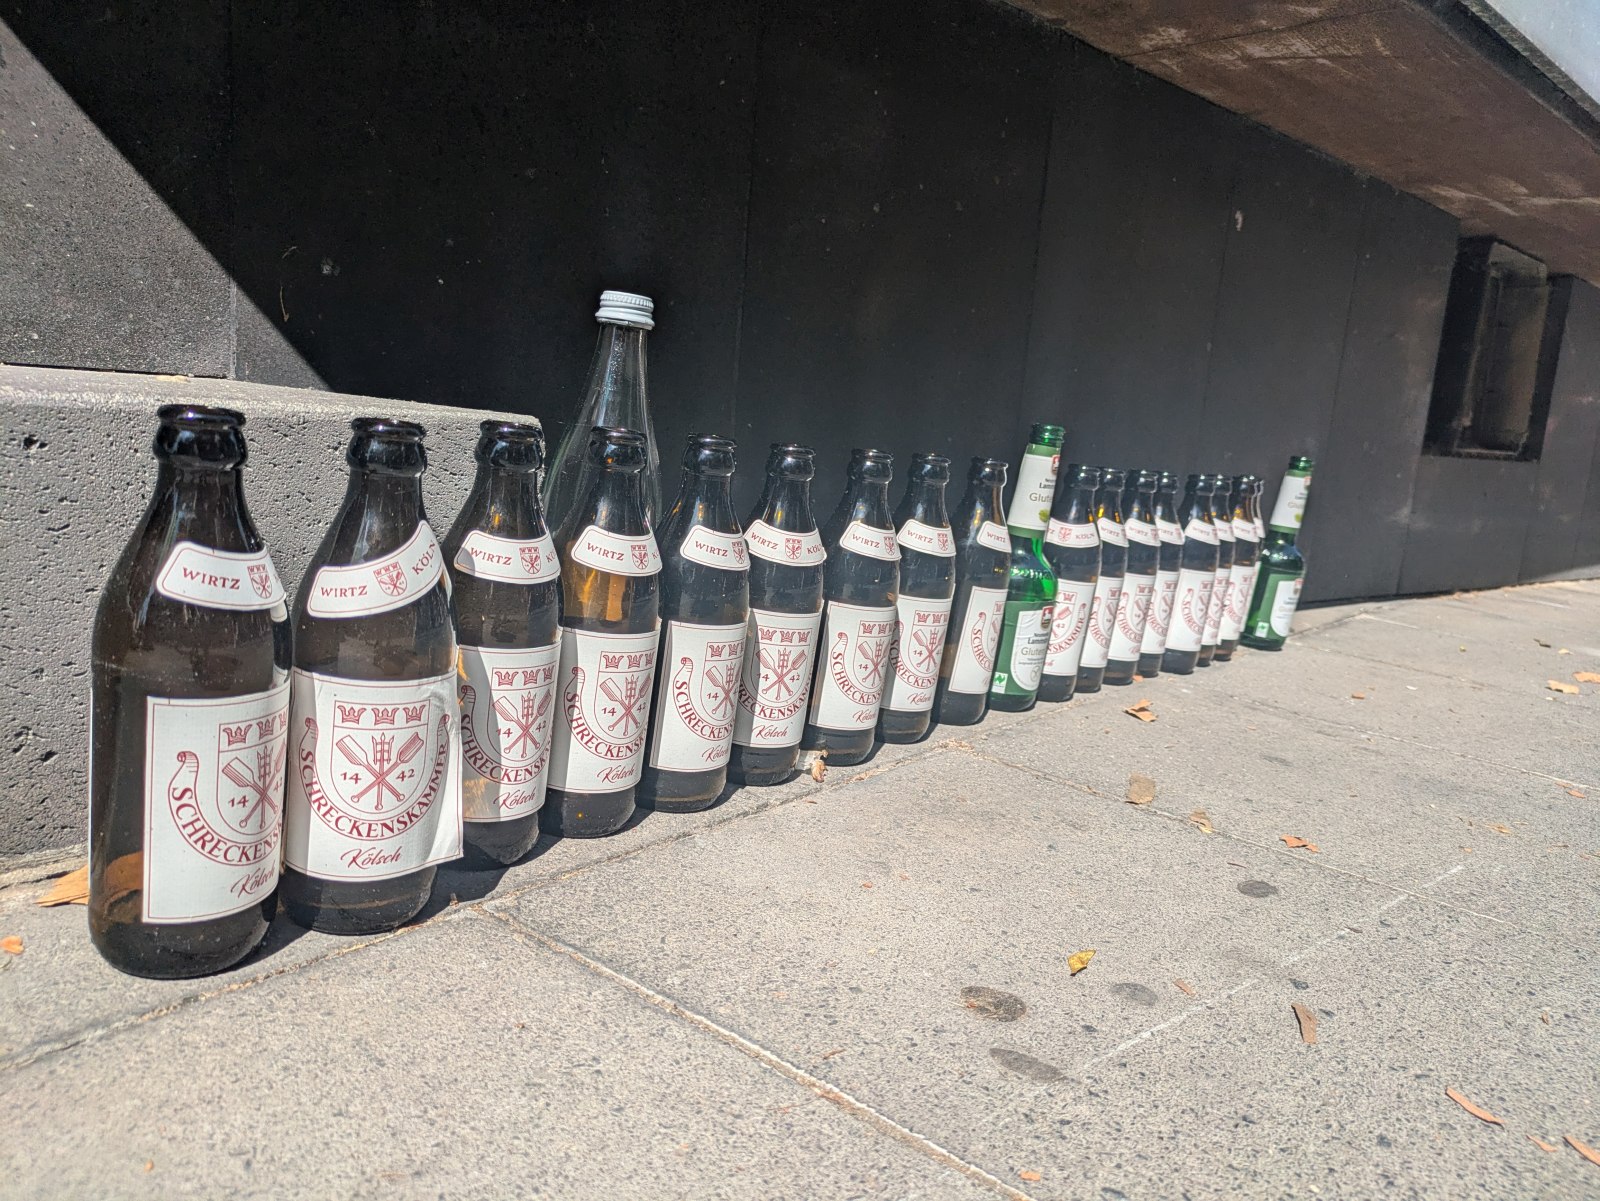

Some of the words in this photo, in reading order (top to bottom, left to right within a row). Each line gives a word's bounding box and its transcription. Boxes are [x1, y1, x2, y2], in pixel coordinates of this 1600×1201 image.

[751, 532, 780, 550] WIRTZ
[852, 533, 881, 549] WIRTZ
[907, 529, 933, 544] WIRTZ
[470, 546, 513, 566] WIRTZ
[587, 542, 625, 561] WIRTZ
[695, 540, 728, 557] WIRTZ
[321, 585, 368, 598] WIRTZ
[412, 540, 436, 575] KÖLN
[182, 566, 241, 590] WIRTZ
[913, 650, 923, 658] 14
[858, 663, 869, 671] 14
[790, 674, 801, 683] 42
[707, 692, 720, 702] 14
[602, 706, 617, 717] 14
[496, 727, 513, 738] 14
[535, 719, 546, 732] 42
[752, 725, 788, 739] Kölsch
[340, 772, 362, 784] 14
[396, 768, 415, 782] 42
[597, 763, 635, 784] Kölsch
[300, 744, 448, 839] SCHRECKENSKAMMER
[493, 786, 535, 810] Kölsch
[228, 795, 250, 808] 14
[340, 846, 403, 870] Kölsch
[230, 860, 276, 898] Kölsch
